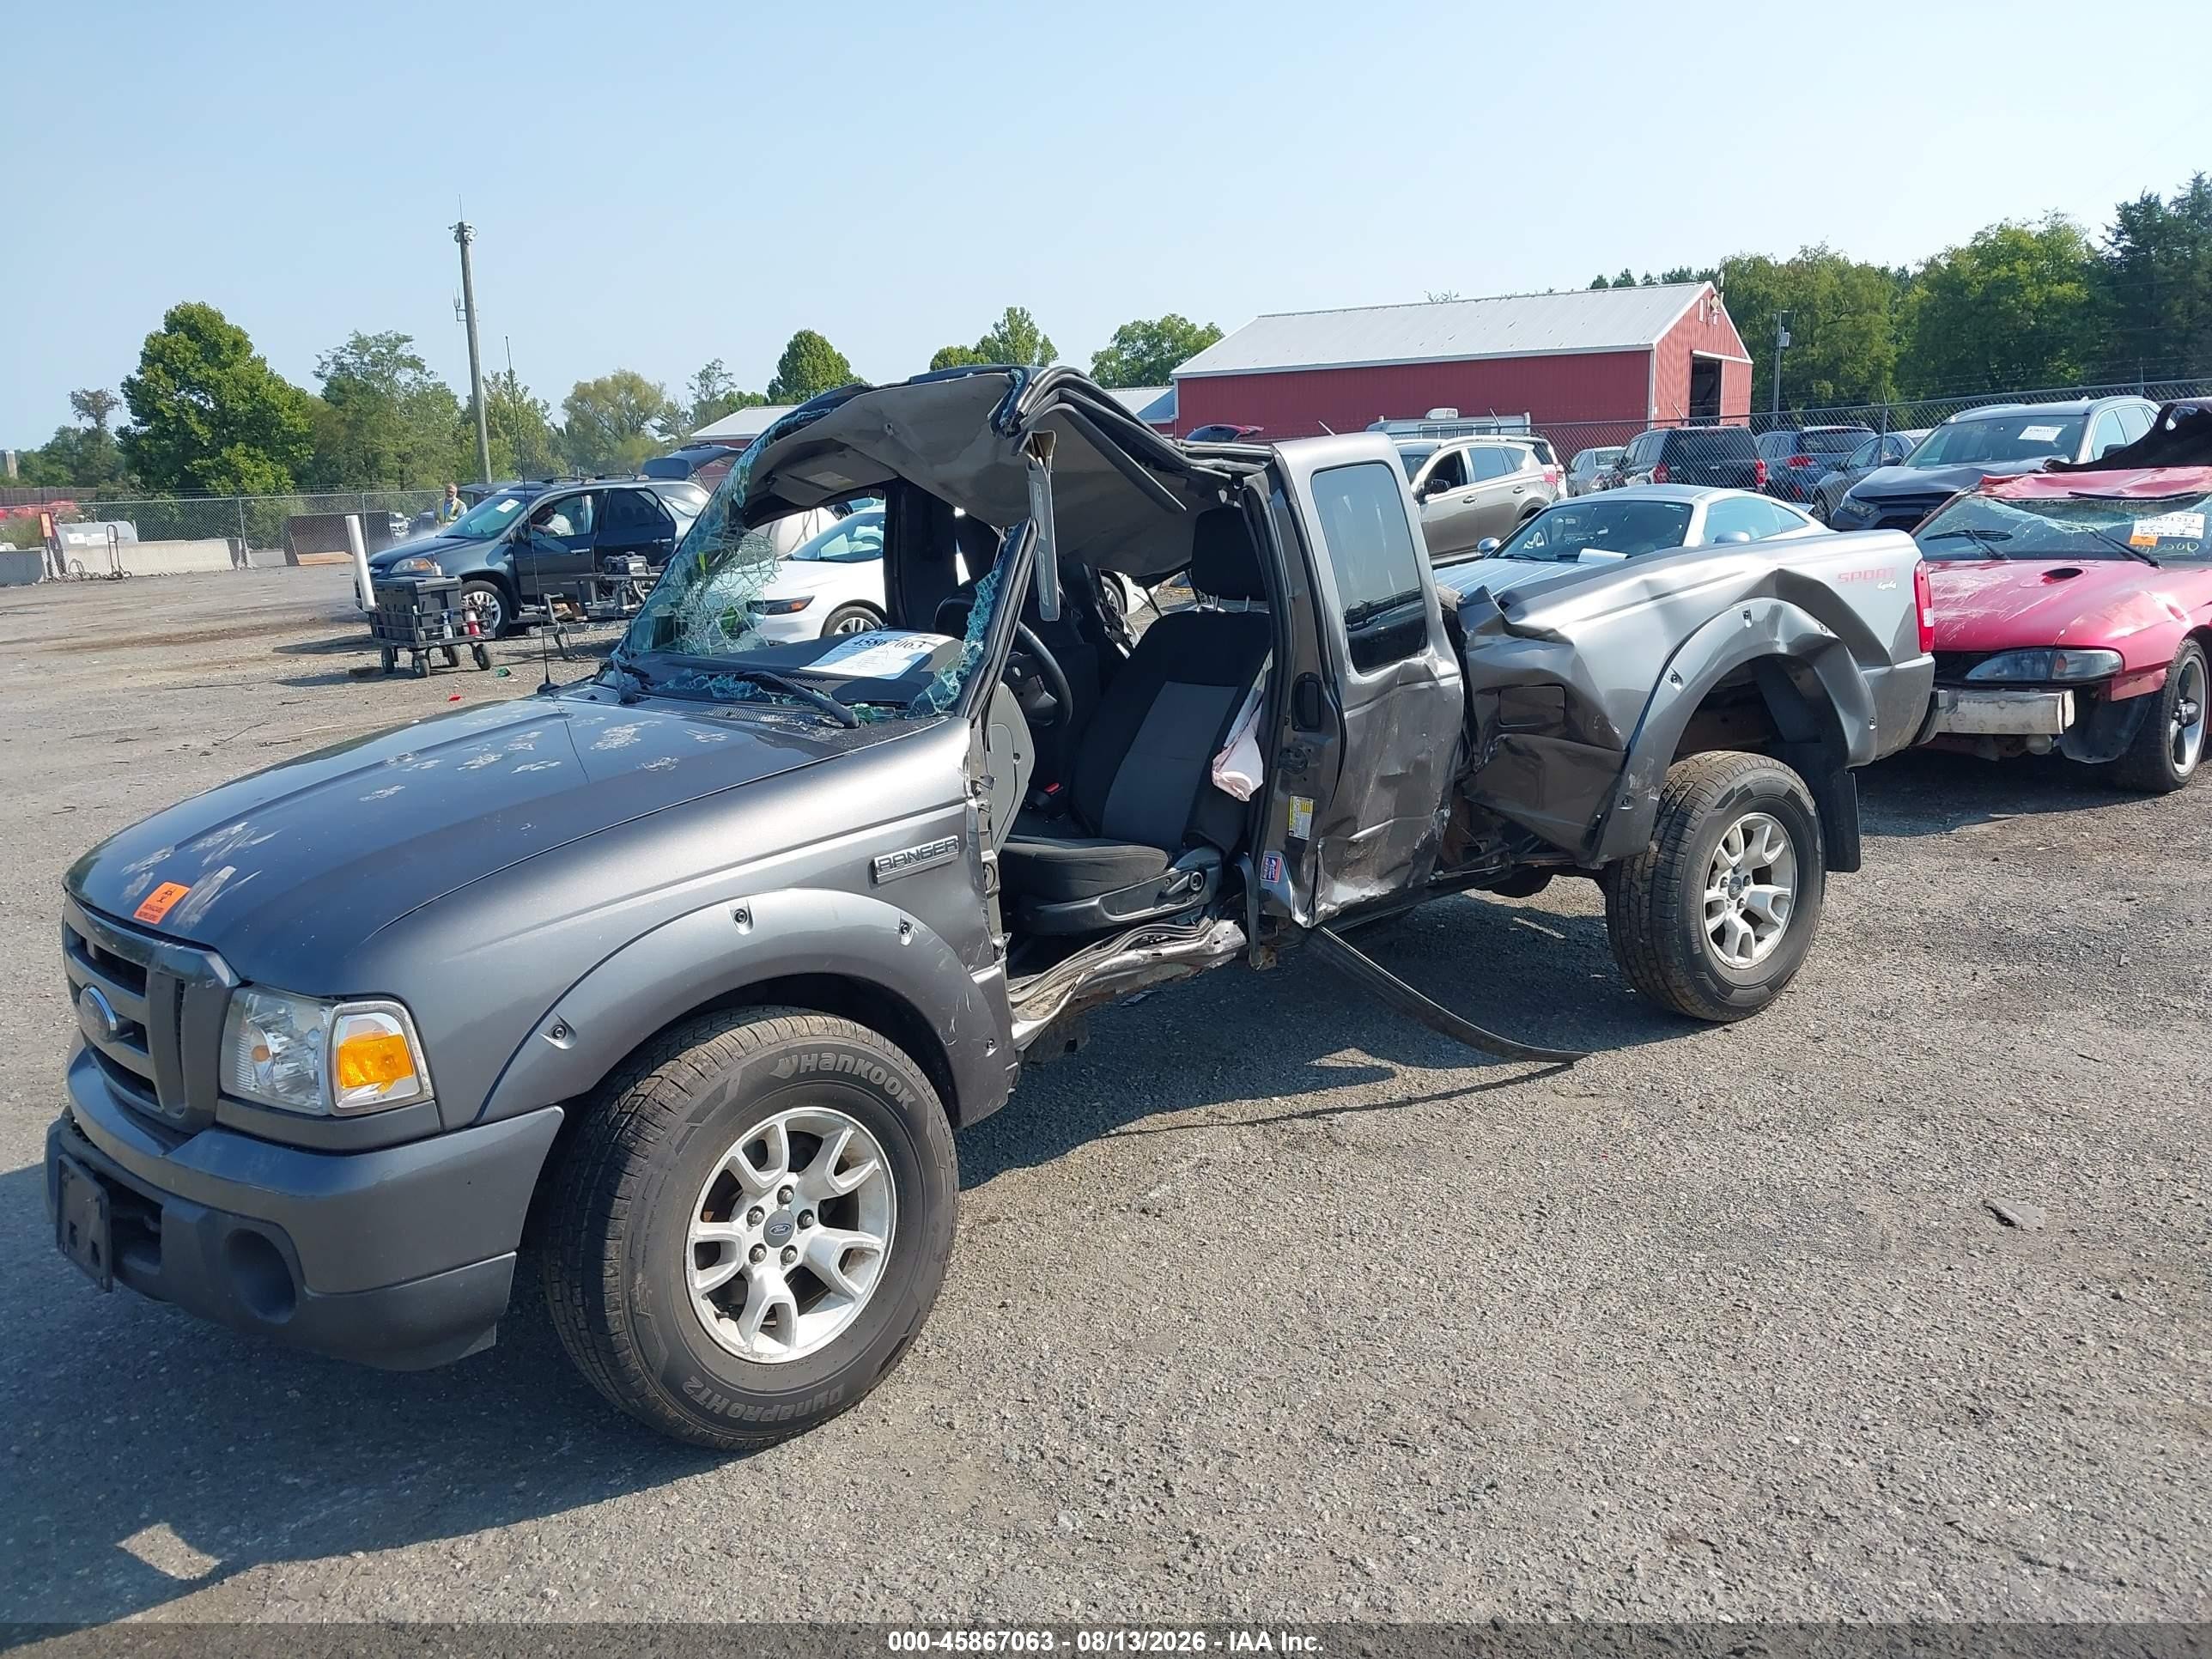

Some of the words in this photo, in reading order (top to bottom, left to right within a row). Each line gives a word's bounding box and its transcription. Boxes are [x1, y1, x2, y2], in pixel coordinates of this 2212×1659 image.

[1838, 568, 1896, 583] SPORT
[851, 637, 927, 650] 45867063
[877, 837, 959, 872] RANGER
[680, 1375, 730, 1415] HT2
